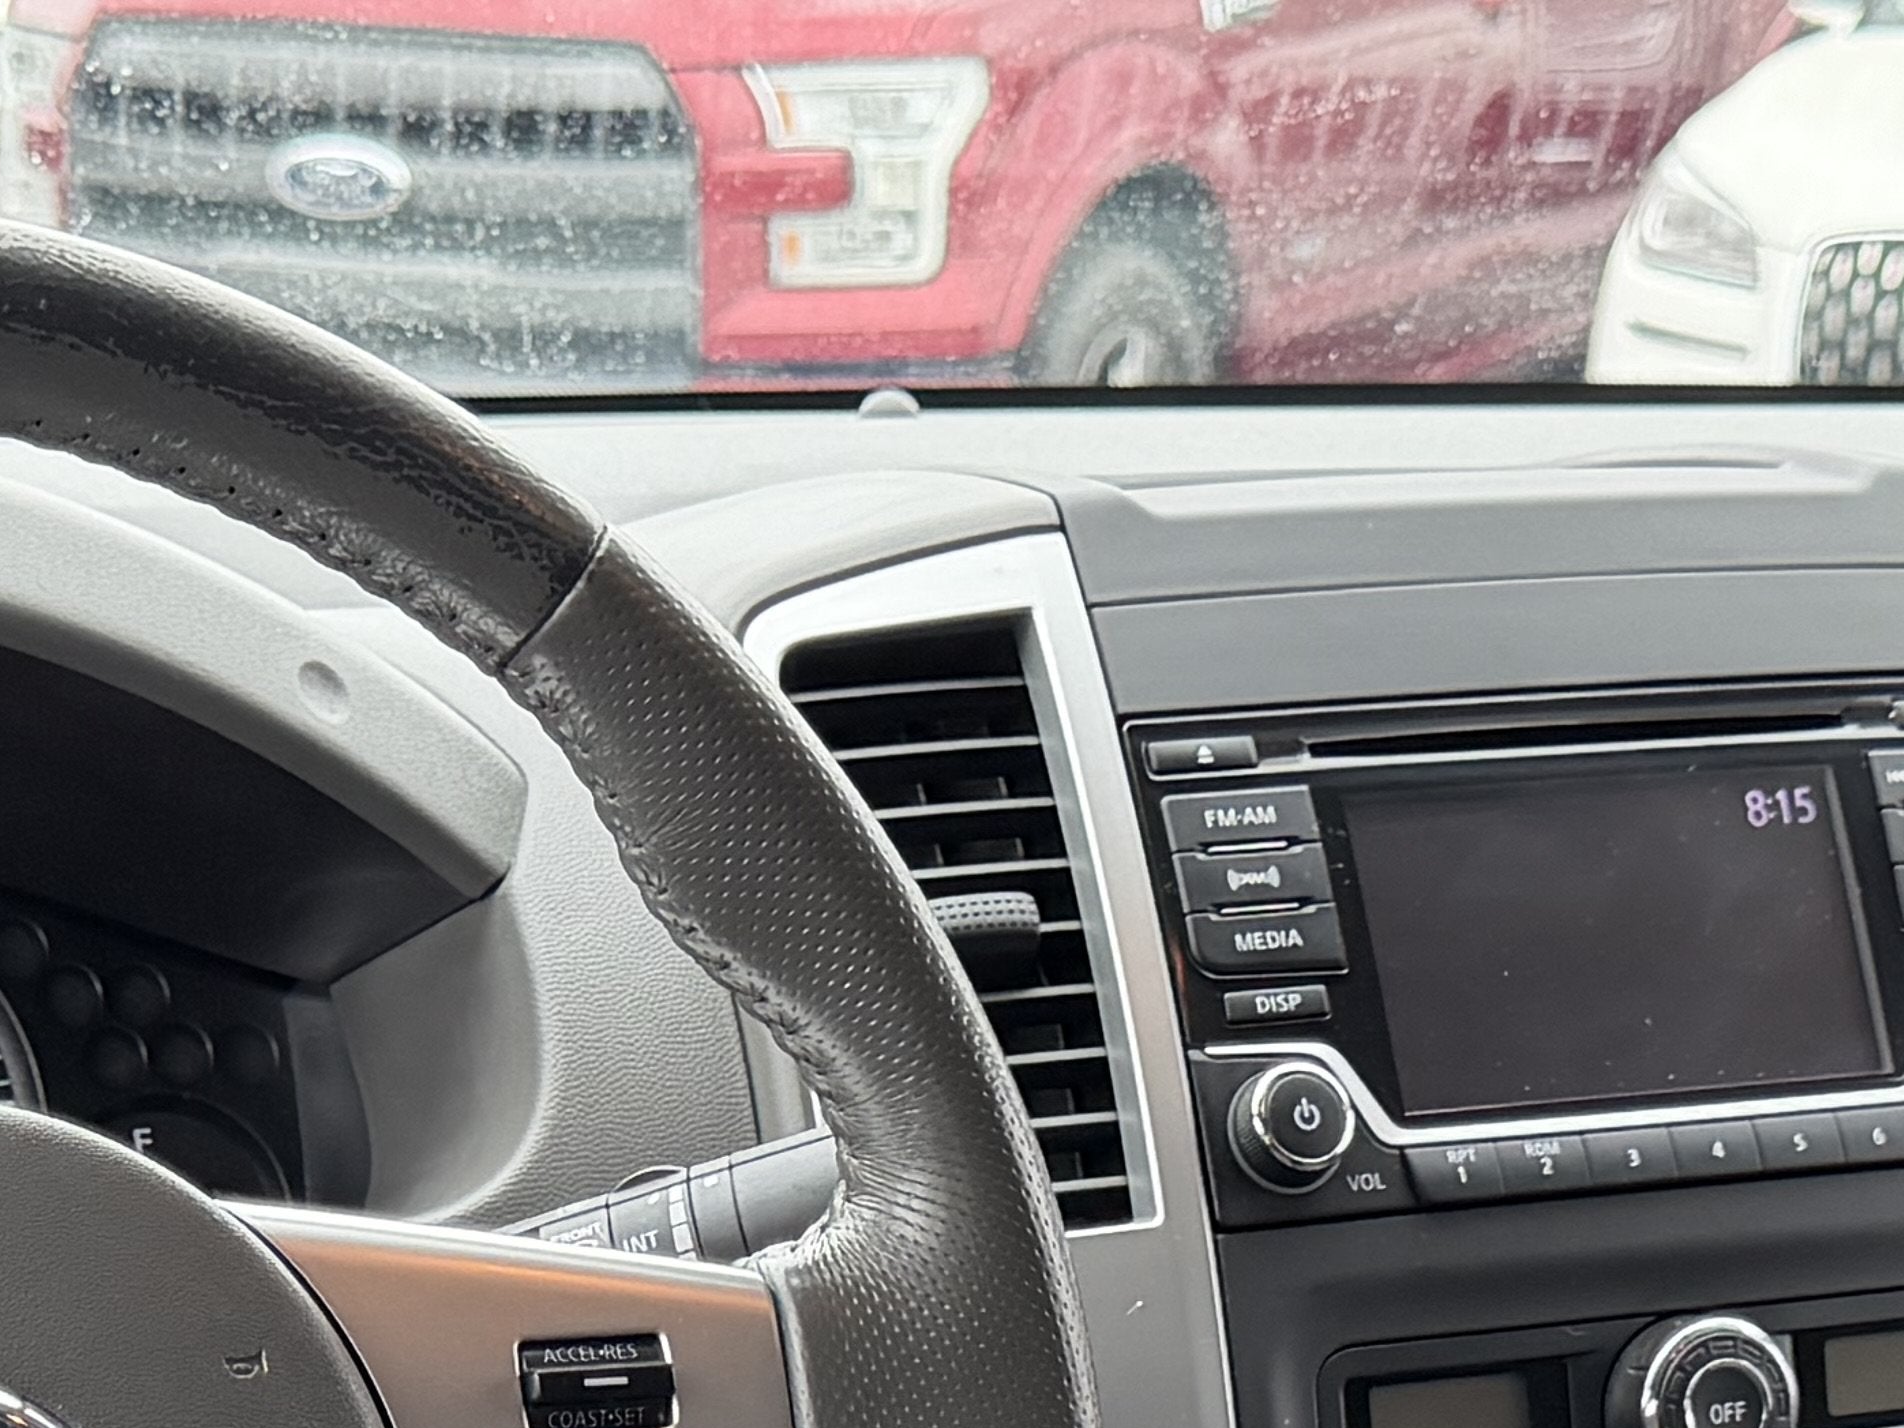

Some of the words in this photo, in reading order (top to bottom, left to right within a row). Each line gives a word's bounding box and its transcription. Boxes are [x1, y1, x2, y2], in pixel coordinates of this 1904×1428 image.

[1744, 785, 1818, 827] 8:15
[1234, 927, 1304, 952] MEDIA
[1255, 993, 1303, 1015] DISP
[132, 1127, 154, 1154] F
[1793, 1133, 1809, 1152] 5
[1871, 1126, 1887, 1146] 6
[1627, 1148, 1643, 1168] 3
[1711, 1140, 1726, 1159] 4
[1456, 1165, 1468, 1184] 1
[1540, 1157, 1555, 1177] 2
[1346, 1173, 1387, 1192] VOL
[551, 1221, 603, 1244] FRONT
[1709, 1399, 1747, 1426] OFF
